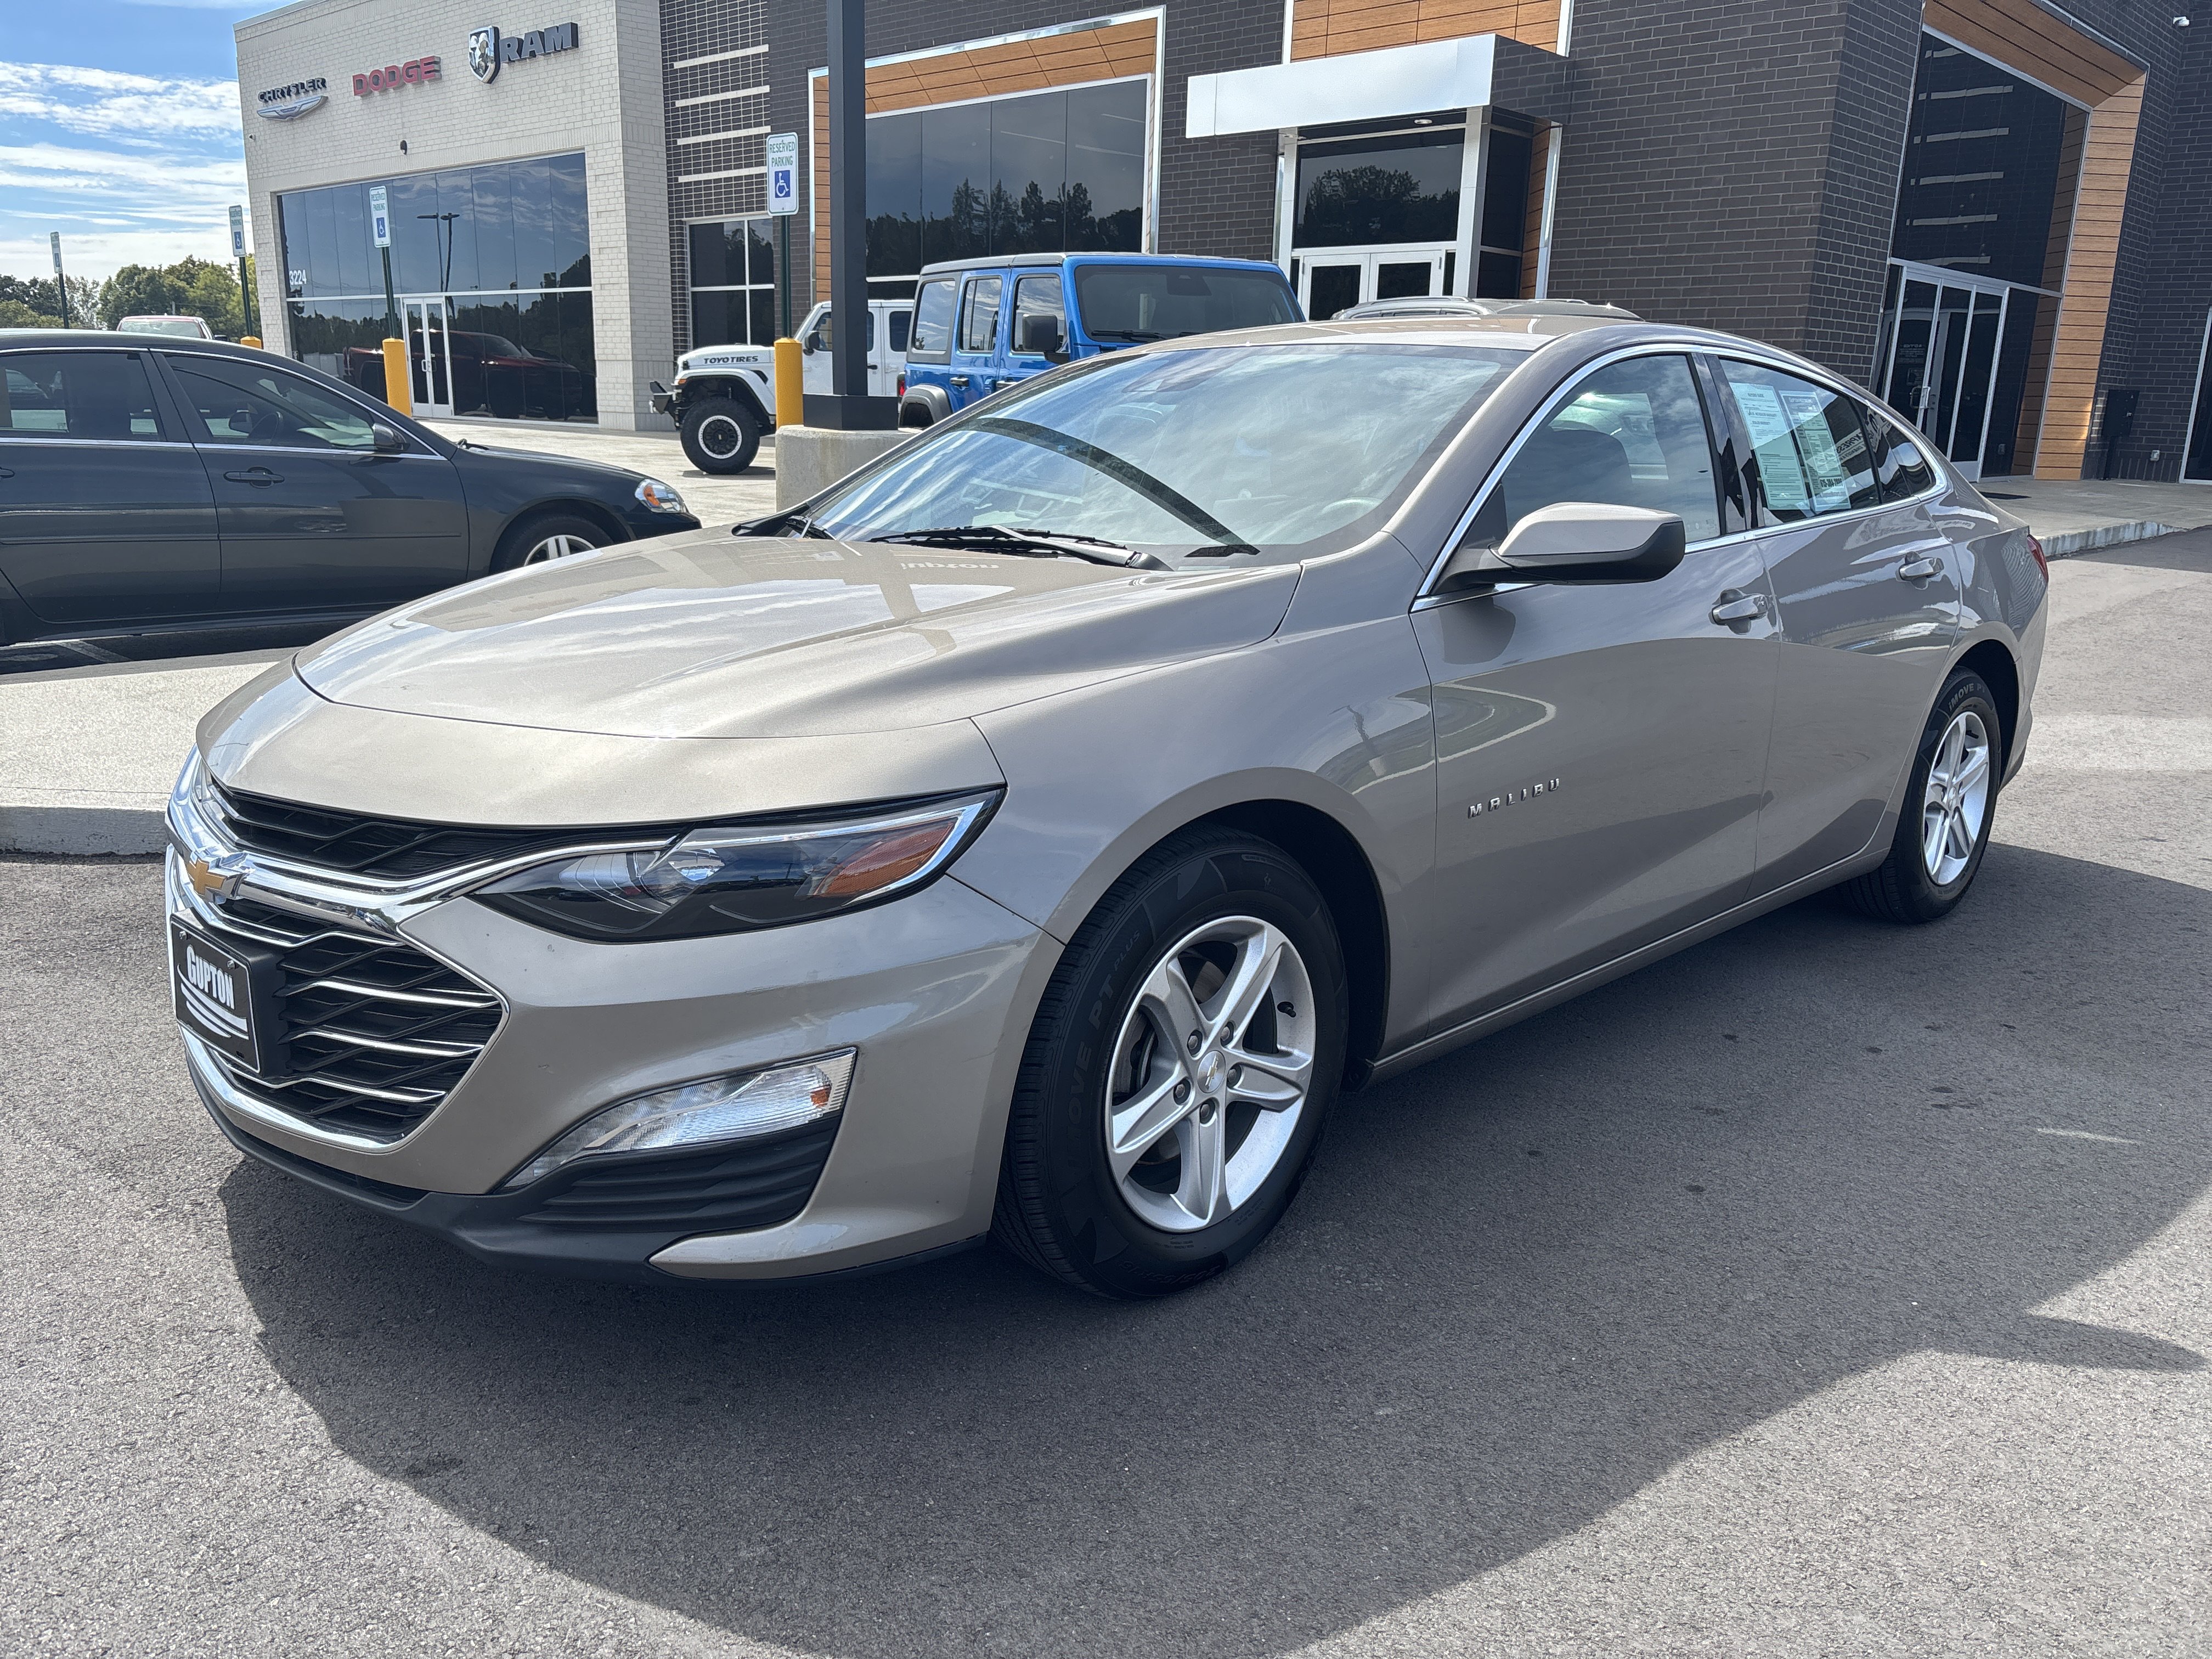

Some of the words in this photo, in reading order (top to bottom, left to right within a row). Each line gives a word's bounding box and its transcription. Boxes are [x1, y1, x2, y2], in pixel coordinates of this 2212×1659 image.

[499, 22, 578, 62] RAM
[258, 77, 327, 103] CHRYSLER
[352, 55, 442, 96] DODGE
[769, 141, 795, 154] RESERVED
[771, 156, 793, 167] PARKING
[289, 269, 307, 285] 3224
[1468, 778, 1560, 819] MALIBU
[1113, 929, 1141, 973] PLUS
[187, 944, 235, 1010] GUPTON
